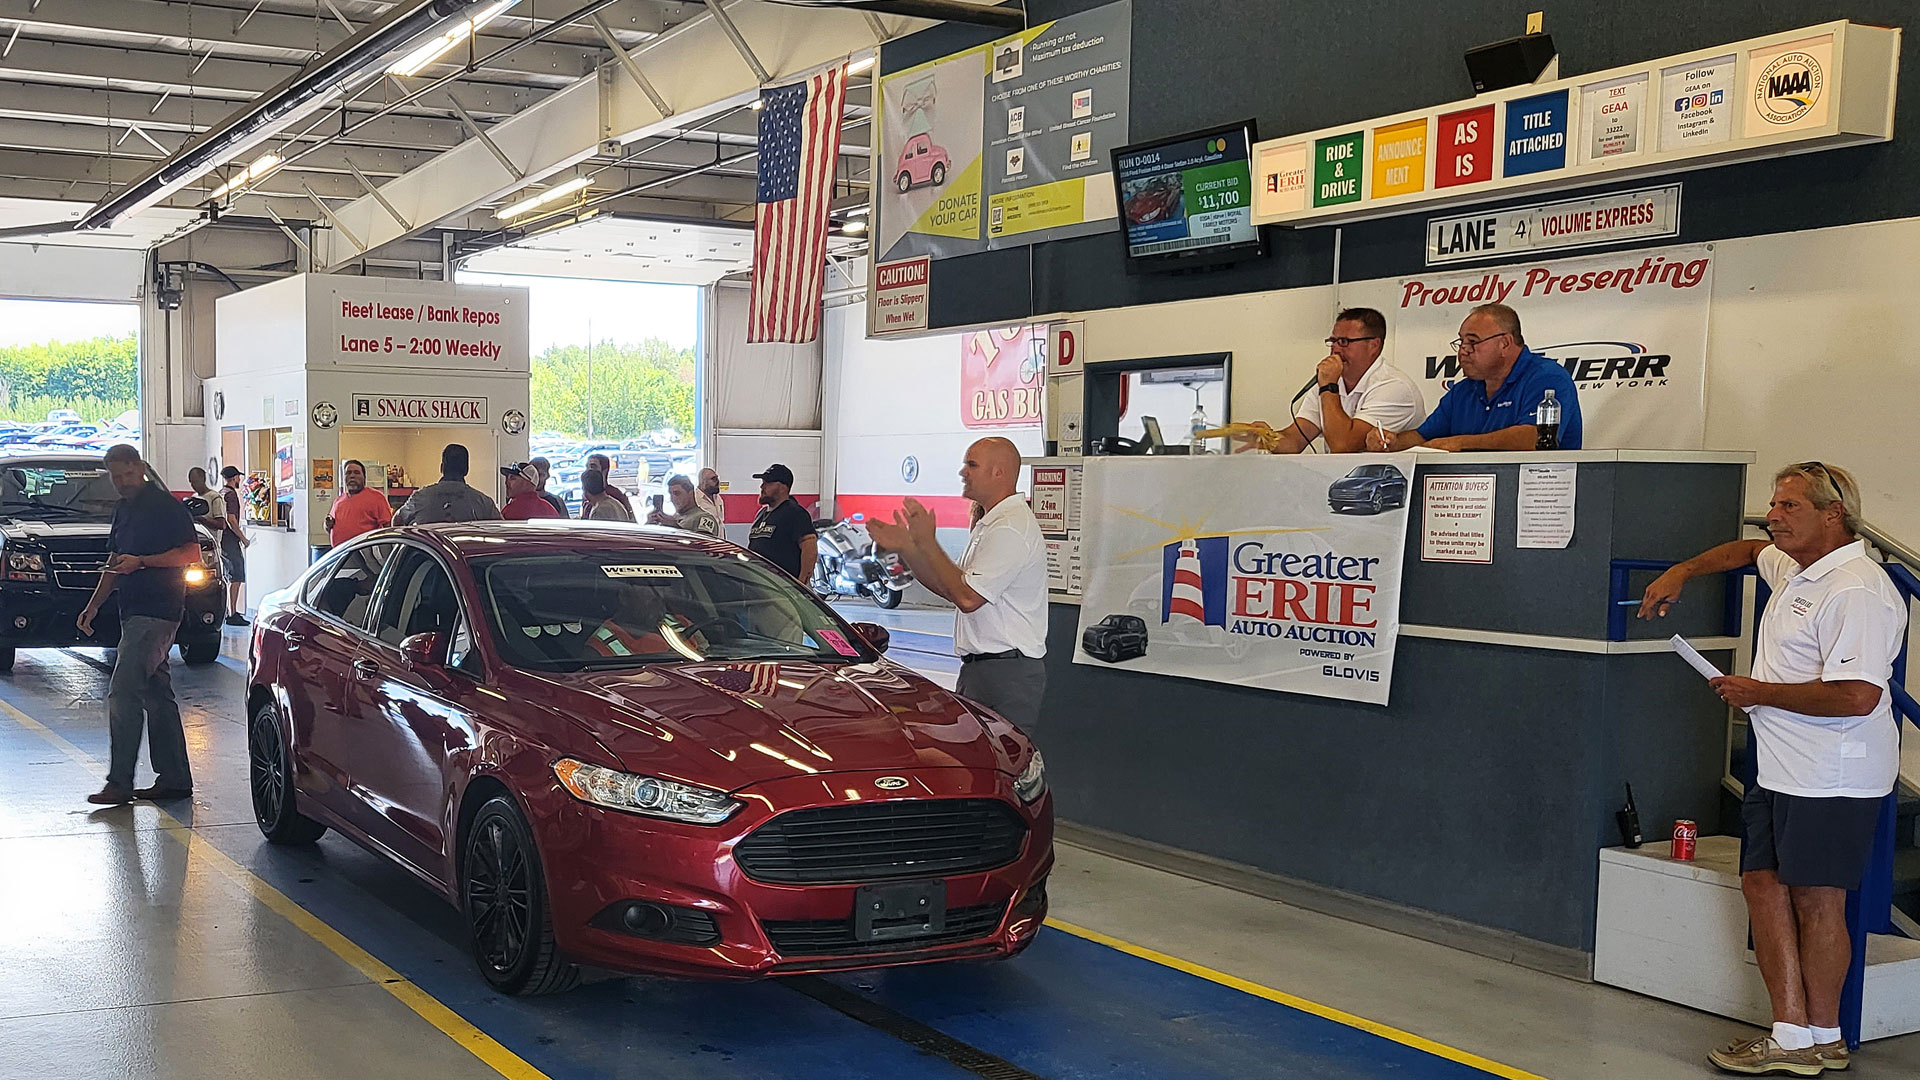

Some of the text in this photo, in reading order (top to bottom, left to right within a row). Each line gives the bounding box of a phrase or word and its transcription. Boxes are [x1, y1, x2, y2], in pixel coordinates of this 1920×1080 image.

[1032, 32, 1076, 51] Running or not
[1032, 36, 1104, 62] Maximum tax deduction
[1685, 68, 1715, 81] Follow
[1757, 54, 1821, 100] NATIONAL AUTO AUCTION
[1768, 69, 1811, 98] NAAA
[992, 90, 1011, 102] CHOOSE
[1012, 86, 1027, 96] FROM
[1027, 84, 1038, 92] ONE
[1047, 77, 1064, 86] THESE
[1065, 71, 1089, 82] WORTHY
[1609, 86, 1627, 97] TEXT
[1684, 85, 1700, 93] GEAA
[1010, 111, 1023, 123] ACB
[1601, 101, 1629, 114] GEAA
[1680, 107, 1713, 119] Facebook
[1765, 106, 1807, 122] ASSOCIATION
[1523, 110, 1551, 130] TITLE
[1606, 125, 1623, 134] 33222
[1677, 119, 1708, 130] Instagram
[1454, 120, 1478, 146] AS
[1682, 127, 1709, 138] LinkedIn
[1326, 142, 1354, 162] RIDE
[1377, 137, 1423, 162] ANNOUNCE
[1509, 132, 1563, 156] ATTACHED
[1119, 152, 1160, 170] RUN D-0014
[1334, 162, 1343, 177] &
[1455, 153, 1474, 177] IS
[1195, 177, 1238, 192] CURRENT BID
[1385, 165, 1409, 185] MENT
[1321, 179, 1356, 199] DRIVE
[938, 193, 977, 211] DONATE
[1198, 190, 1240, 210] $11,700
[930, 208, 977, 227] YOUR CAR
[1437, 202, 1654, 256] LANE 4 VOLUME EXPRESS
[879, 263, 925, 286] CAUTION!
[1400, 256, 1710, 309] Proudly Presenting
[877, 293, 924, 308] Floor is Slippery
[342, 301, 500, 327] Fleet Lease / Bank Repos
[885, 311, 915, 324] When Wet
[341, 335, 501, 361] Lane 5 2:00 Weekly
[1058, 330, 1075, 366] D
[1615, 378, 1669, 389] YORK
[377, 399, 480, 419] SNACK SHACK
[971, 388, 1009, 421] GAS
[1429, 481, 1489, 491] ATTENTION BUYERS
[1041, 500, 1056, 510] 24HR
[1233, 542, 1379, 581] Greater
[1232, 576, 1377, 628] ERIE
[1230, 620, 1376, 648] AUTO AUCTION
[1300, 649, 1340, 659] POWERED
[1322, 665, 1379, 682] GLOVIS
